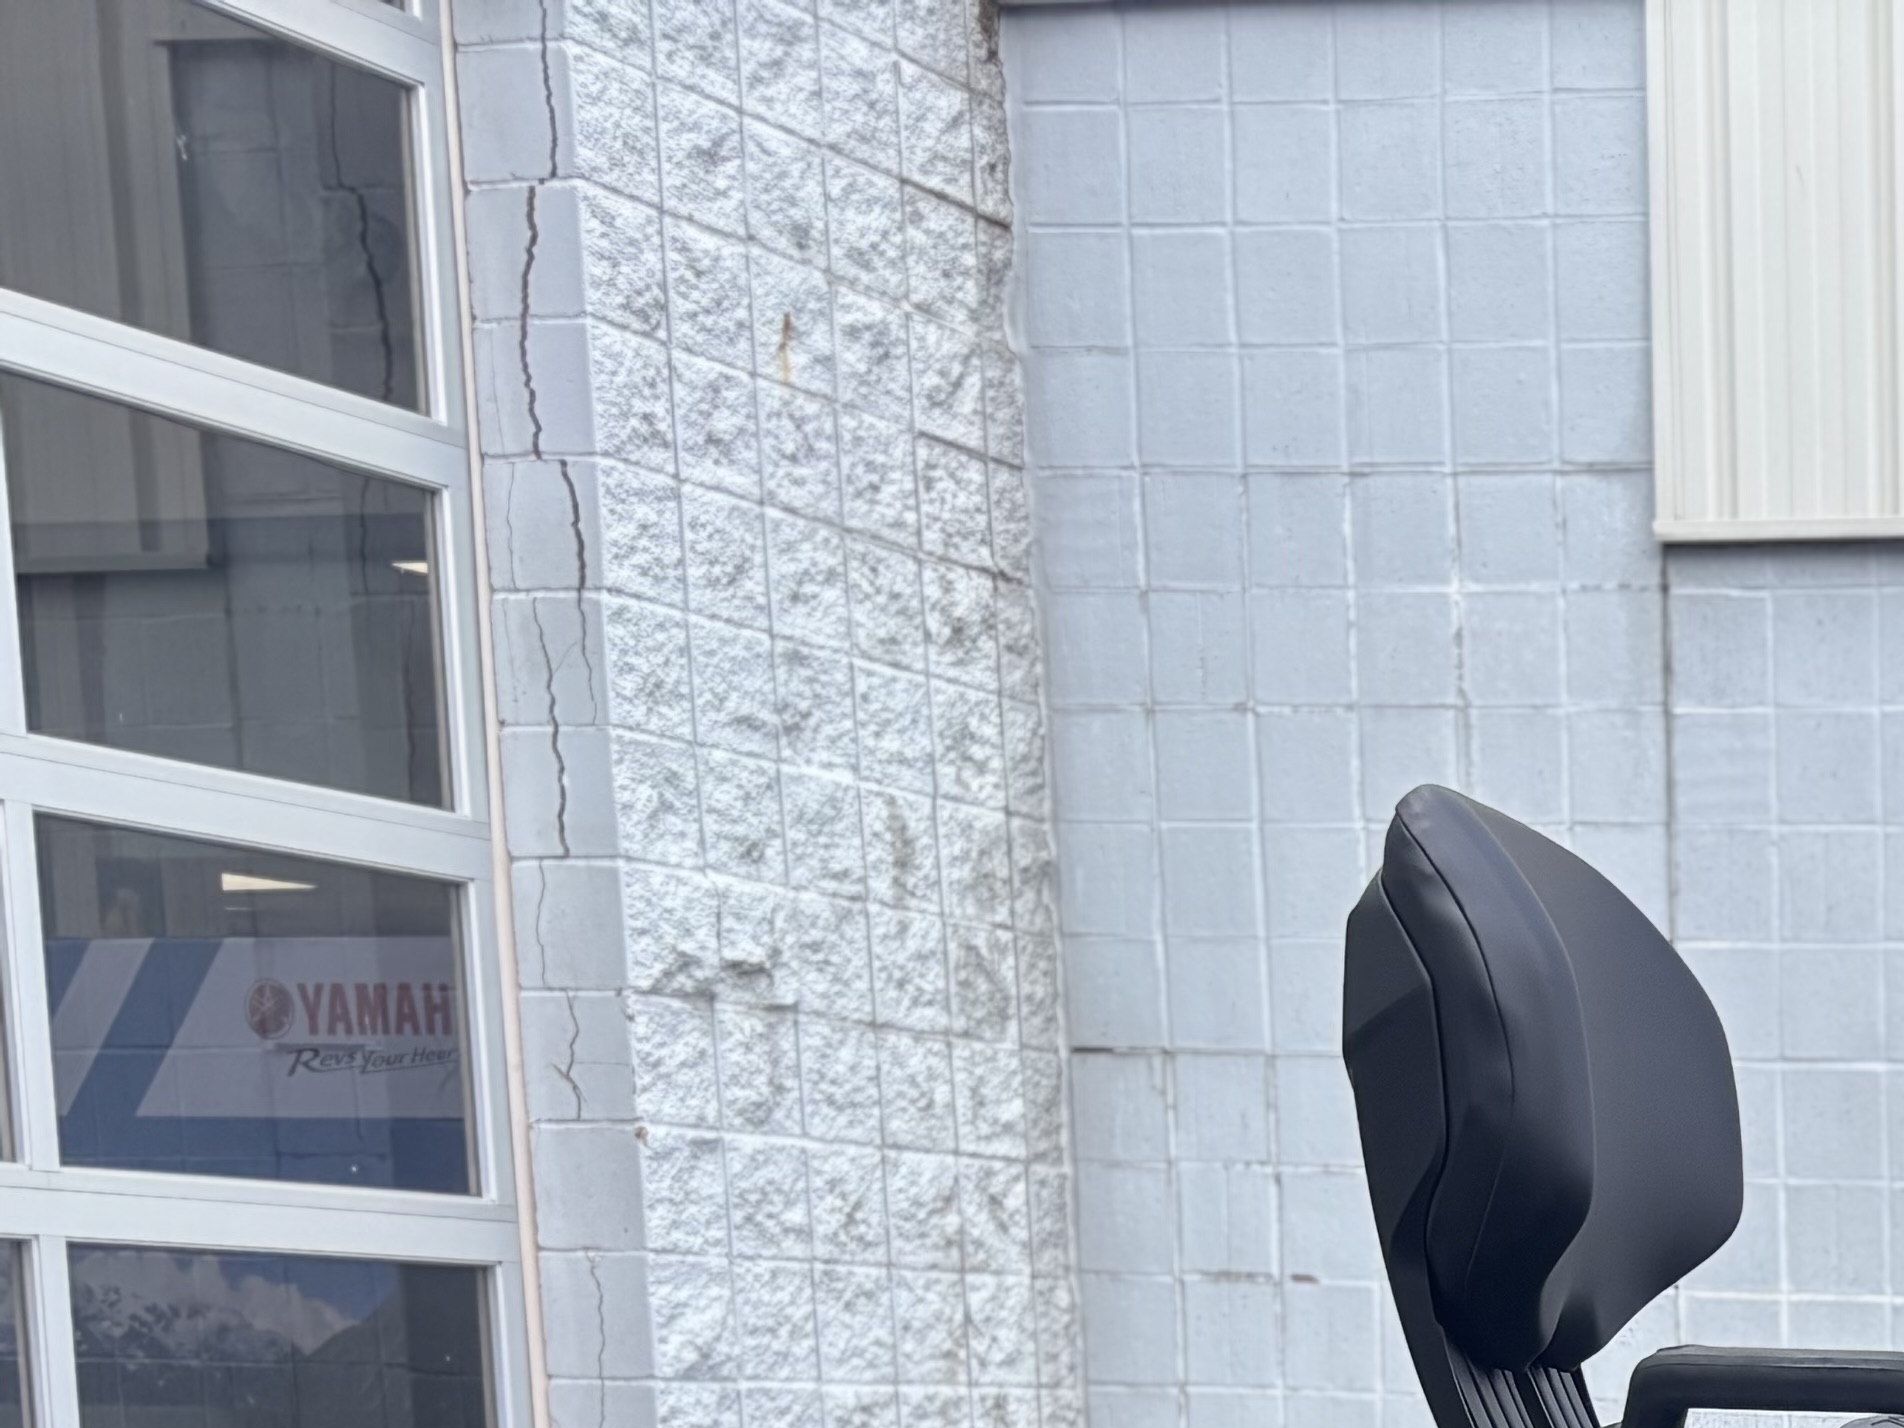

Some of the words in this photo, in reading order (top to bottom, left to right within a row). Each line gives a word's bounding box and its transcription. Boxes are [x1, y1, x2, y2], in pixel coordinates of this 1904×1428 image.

[297, 982, 453, 1036] YAMAH
[287, 1047, 362, 1077] Revs
[360, 1048, 409, 1074] Your
[411, 1047, 457, 1064] Hear
